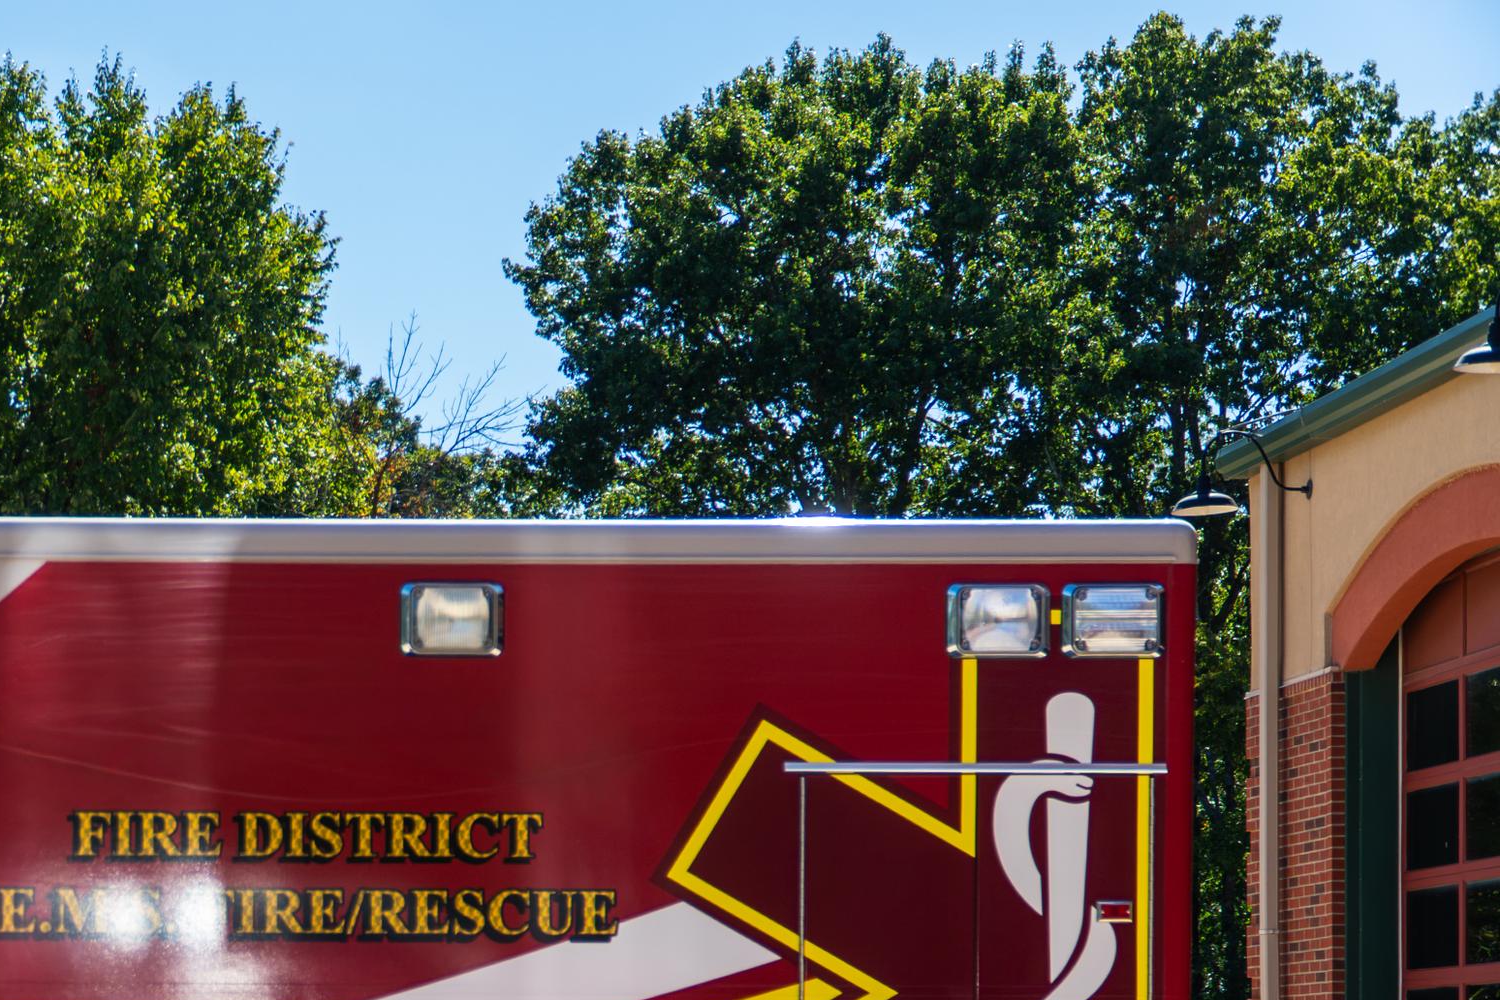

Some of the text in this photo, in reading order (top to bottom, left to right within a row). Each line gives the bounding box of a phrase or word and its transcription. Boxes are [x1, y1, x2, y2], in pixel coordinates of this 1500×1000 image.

[70, 810, 543, 864] FIRE DISTRICT
[199, 887, 620, 942] IRE/RESCUE
